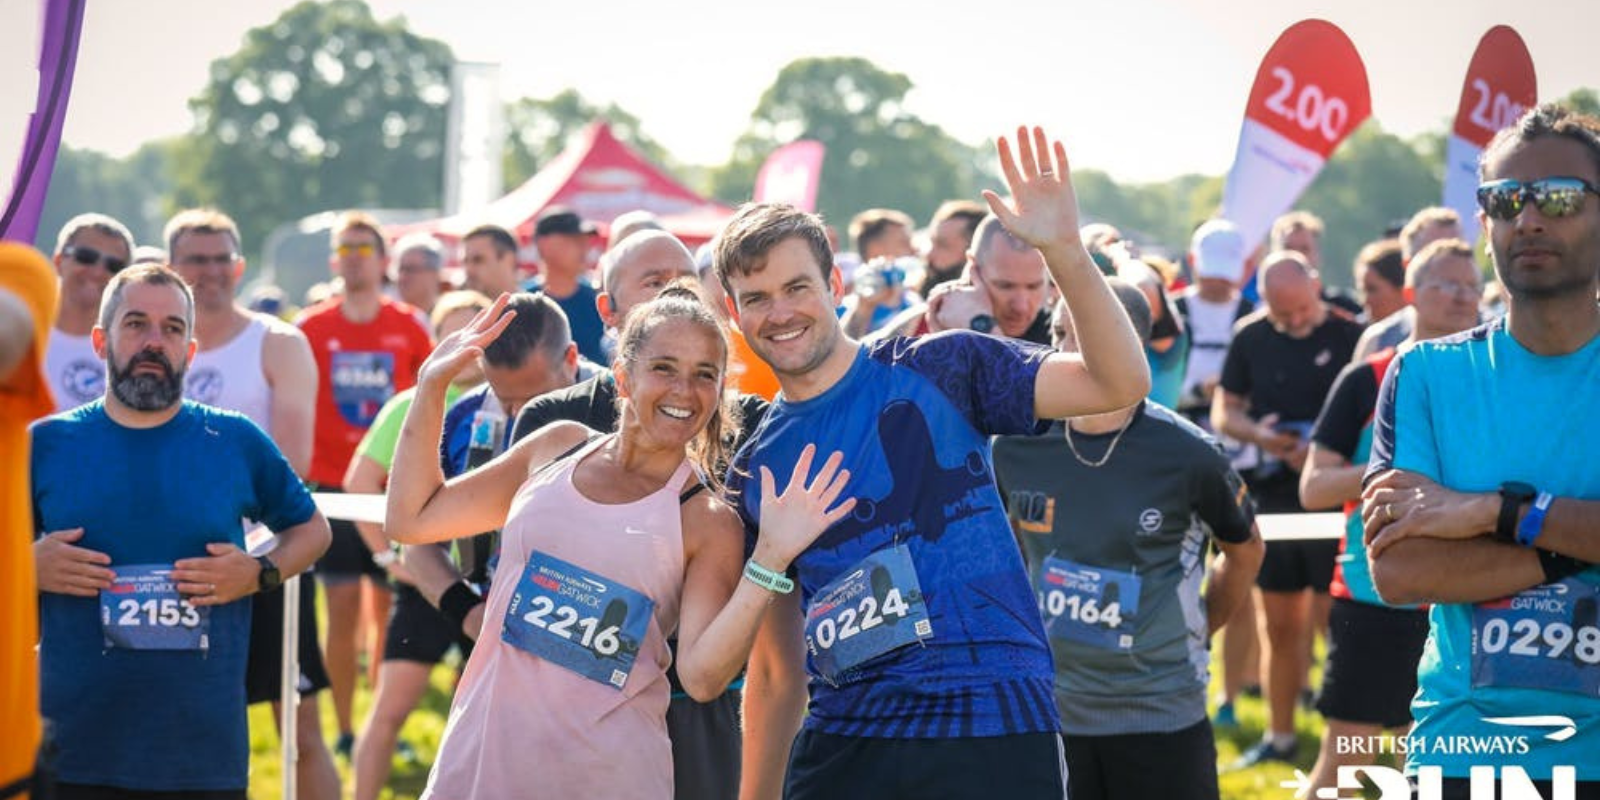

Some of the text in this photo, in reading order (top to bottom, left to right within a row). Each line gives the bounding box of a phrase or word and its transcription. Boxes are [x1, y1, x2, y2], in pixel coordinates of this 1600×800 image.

[1264, 66, 1348, 142] 2.00
[118, 599, 200, 627] 2153
[558, 583, 602, 609] GATWICK
[1047, 590, 1122, 628] 0164
[1511, 597, 1566, 615] GATWICK
[523, 596, 620, 655] 2216
[816, 588, 909, 649] 0224
[1481, 618, 1600, 663] 0298
